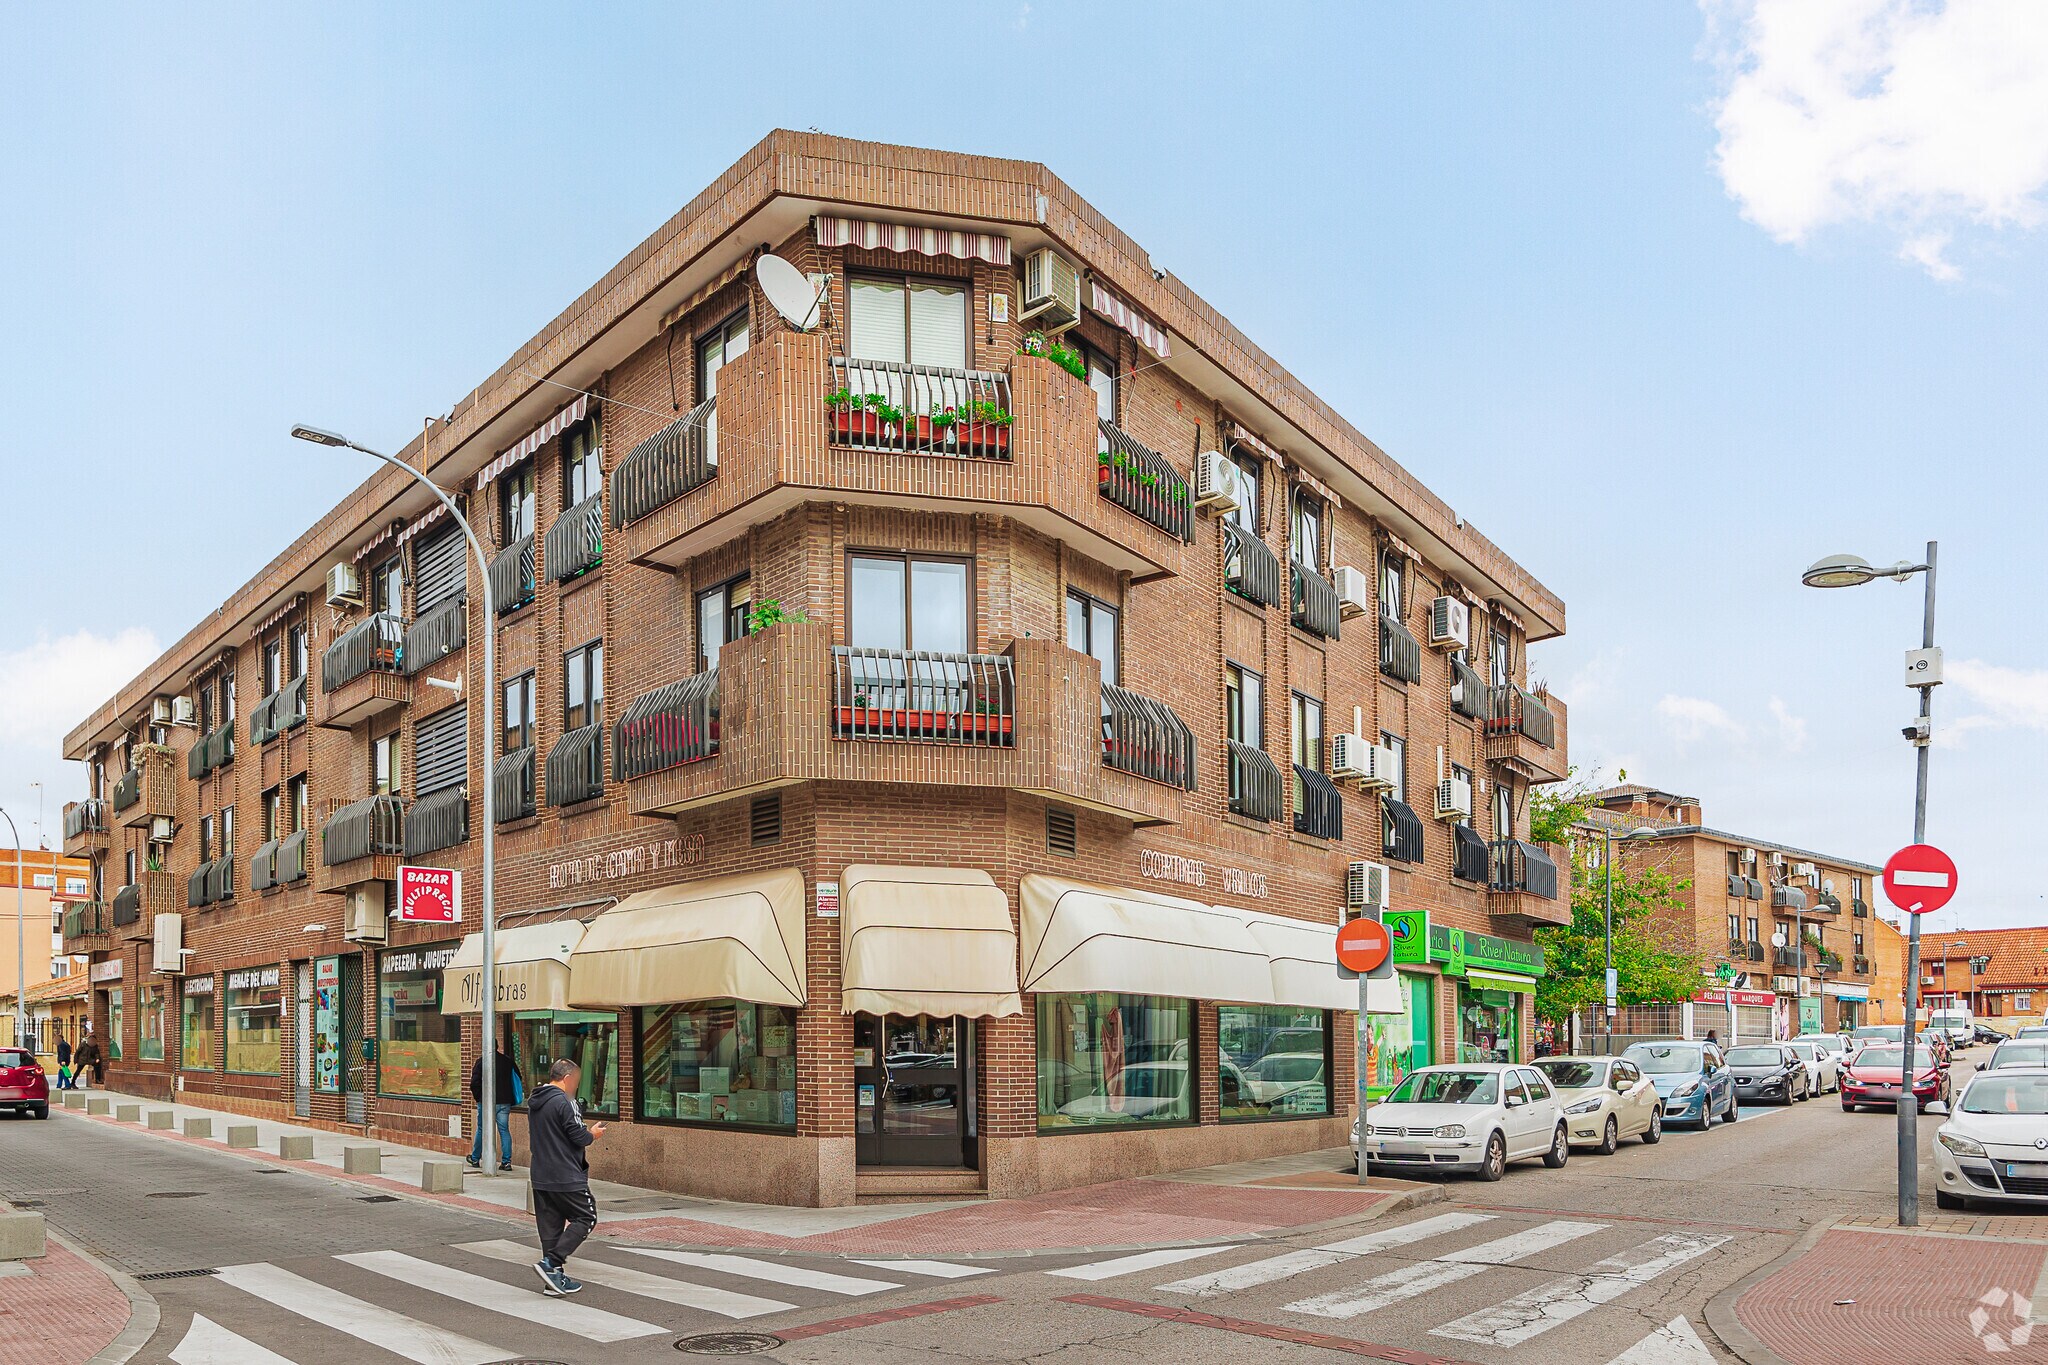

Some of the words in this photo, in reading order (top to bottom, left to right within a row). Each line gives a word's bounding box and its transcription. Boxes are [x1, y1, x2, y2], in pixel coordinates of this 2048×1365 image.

[650, 842, 660, 869] Y
[407, 871, 449, 886] BAZAR
[1140, 849, 1206, 888] CORTINAS
[1220, 866, 1268, 898] VISILLOS
[404, 885, 452, 918] MULTIPRECIO
[1394, 943, 1416, 951] River
[1479, 937, 1504, 958] River
[1503, 940, 1532, 964] Natura
[382, 952, 417, 974] PAPELERIA
[228, 972, 250, 990] MENAJE
[250, 971, 260, 988] DEL
[260, 968, 280, 987] HOGAR
[461, 970, 527, 1009] Alfbras
